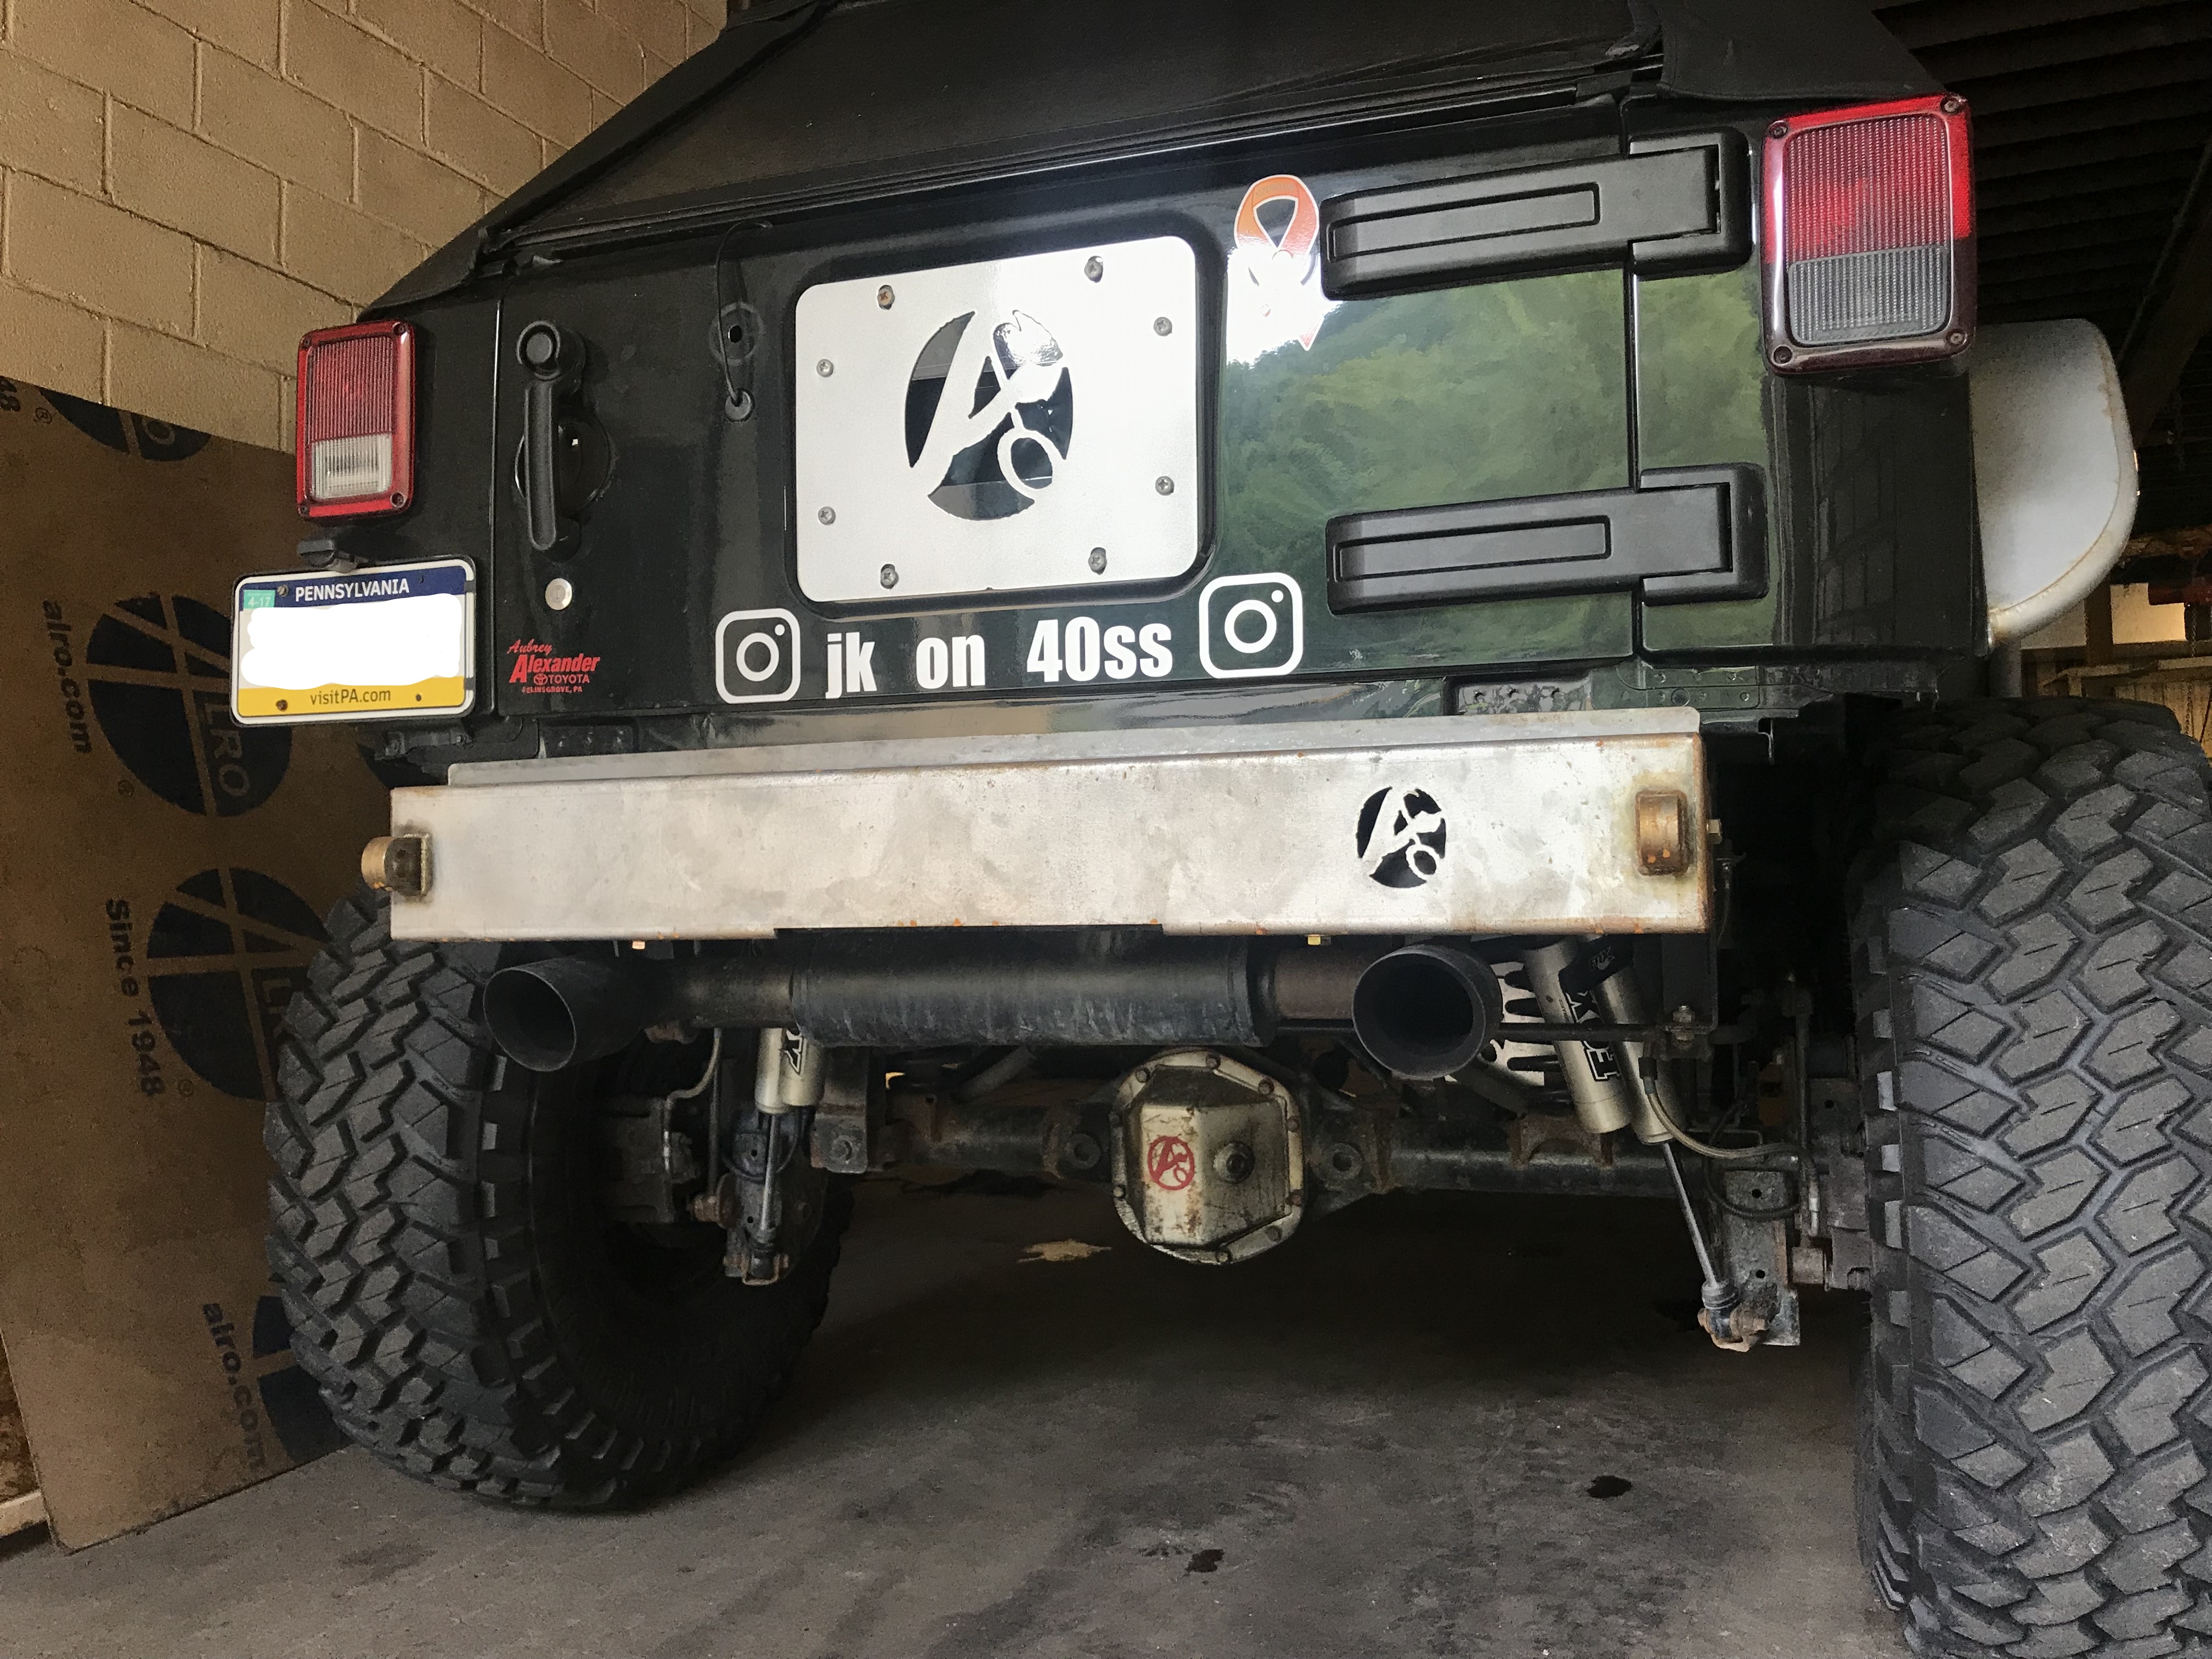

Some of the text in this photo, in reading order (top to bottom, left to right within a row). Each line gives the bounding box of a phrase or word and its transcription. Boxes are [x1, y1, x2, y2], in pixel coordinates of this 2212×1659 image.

[247, 596, 271, 607] 4-17
[295, 578, 410, 602] PENNSYLVANIA
[506, 638, 552, 656] Aubrey
[825, 616, 1173, 699] jk on 40ss
[42, 600, 92, 754] alro.com
[509, 653, 601, 684] Alexander
[549, 674, 590, 684] TOYOTA
[309, 689, 391, 706] visitPA.com
[105, 895, 165, 1096] Since 1948
[202, 1302, 266, 1471] alro.com
